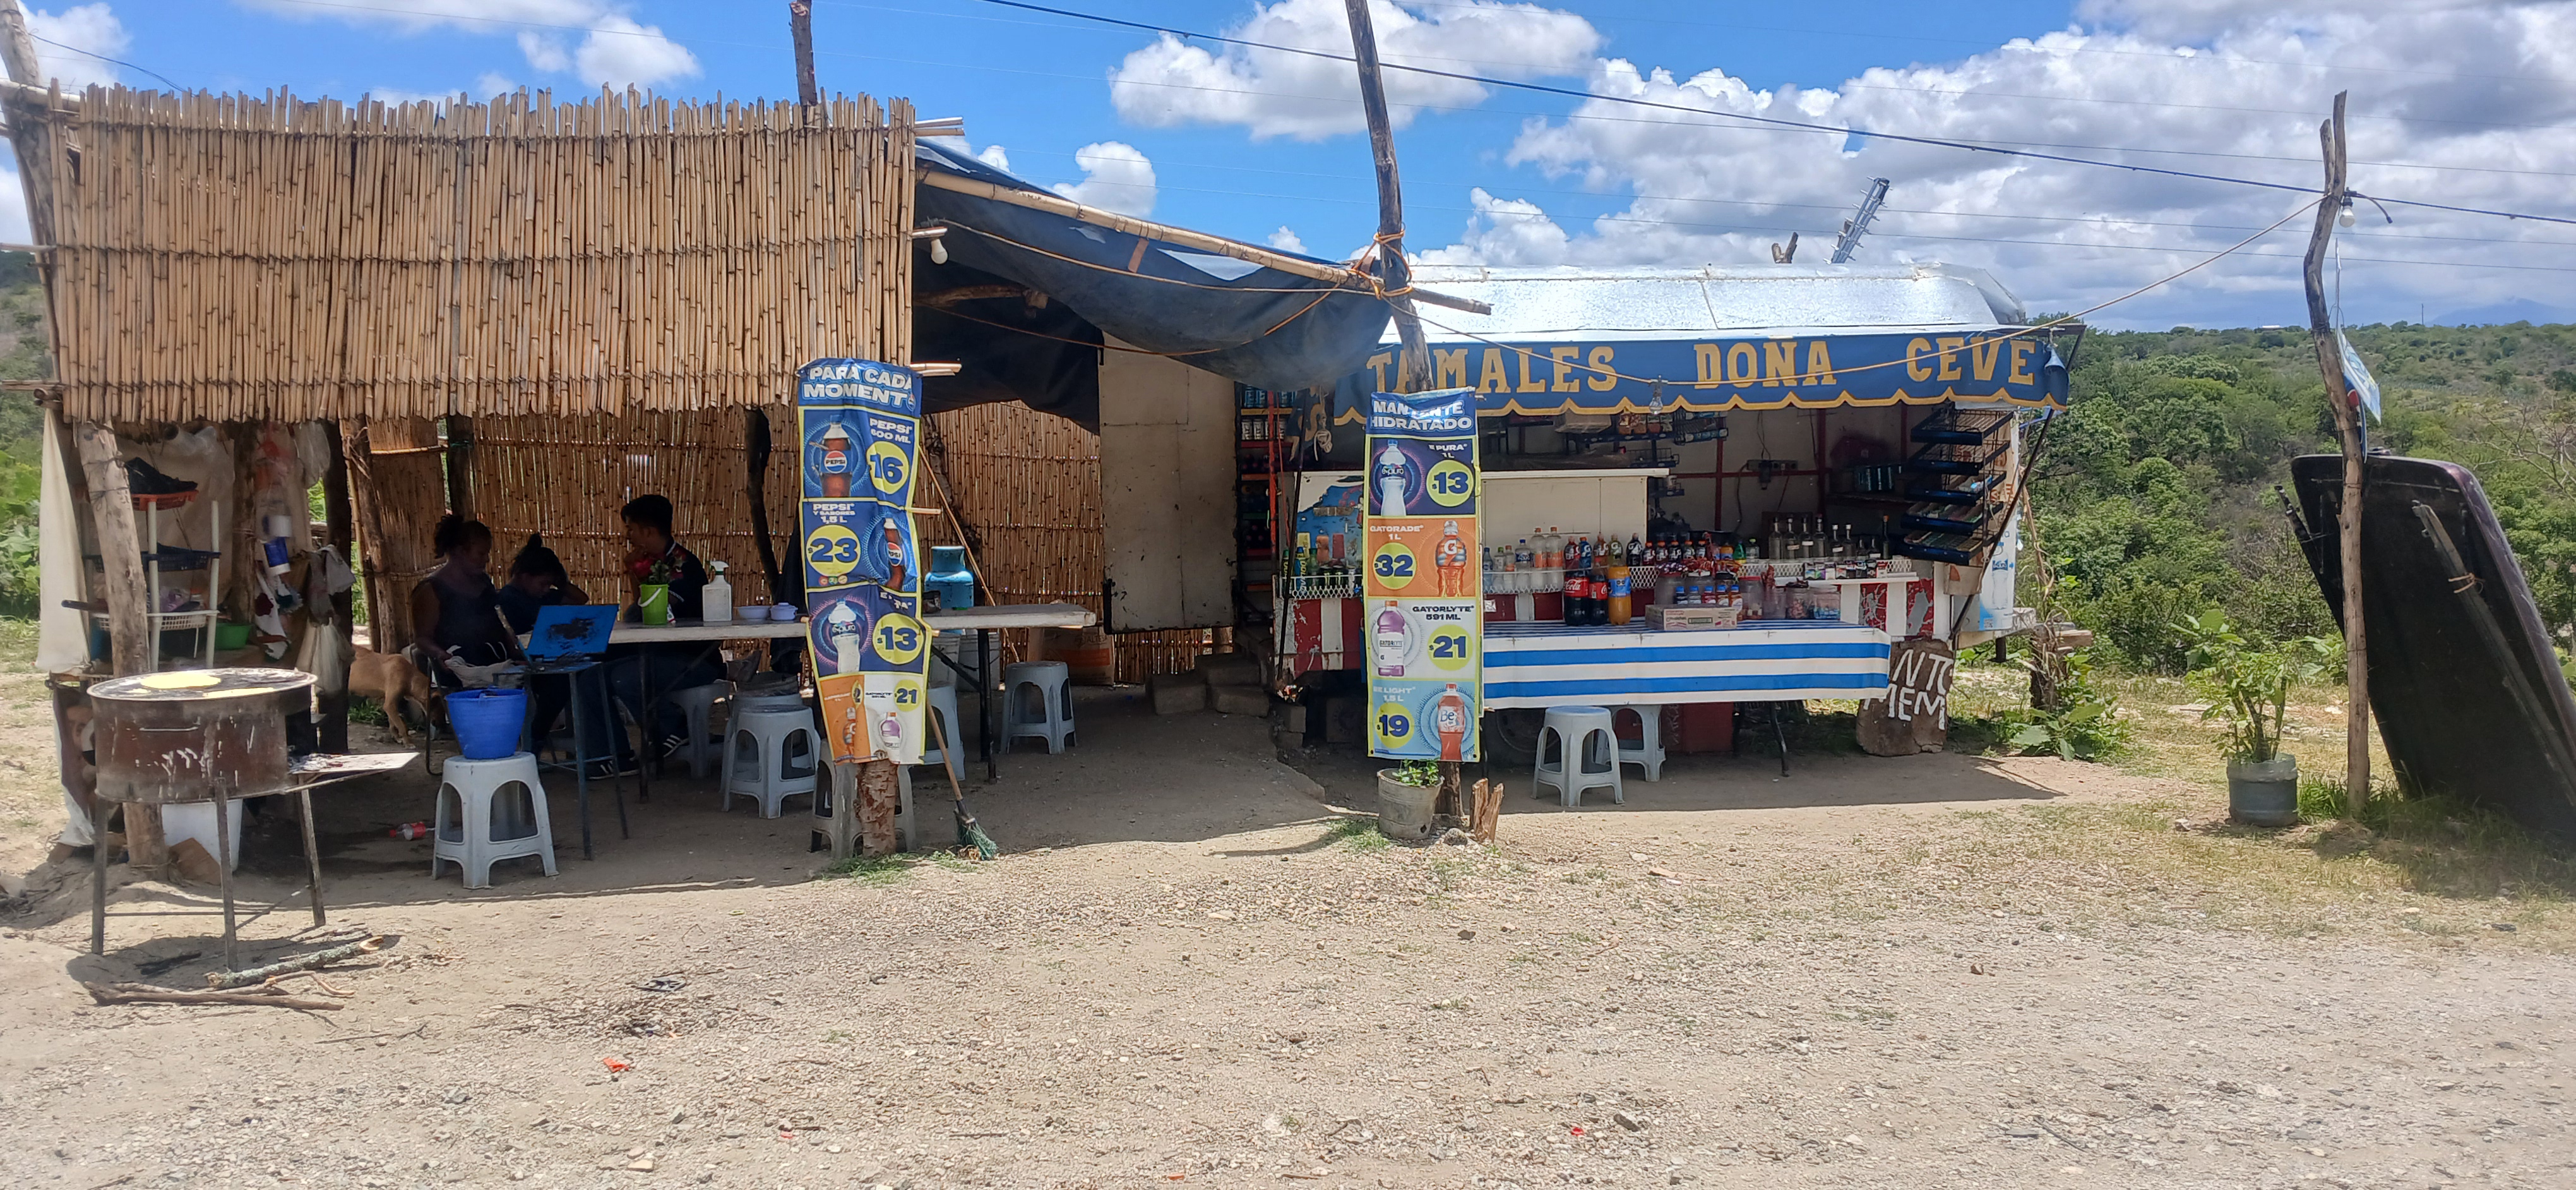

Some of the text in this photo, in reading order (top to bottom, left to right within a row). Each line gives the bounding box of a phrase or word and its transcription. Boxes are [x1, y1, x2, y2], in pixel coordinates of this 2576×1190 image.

[1366, 337, 2036, 394] TAMALES DONA CEVE
[810, 366, 912, 389] PARA CADA
[1371, 416, 1472, 431] HIDRATADO
[895, 433, 911, 443] ML
[869, 453, 903, 484] 16
[1440, 710, 1455, 722] Be
